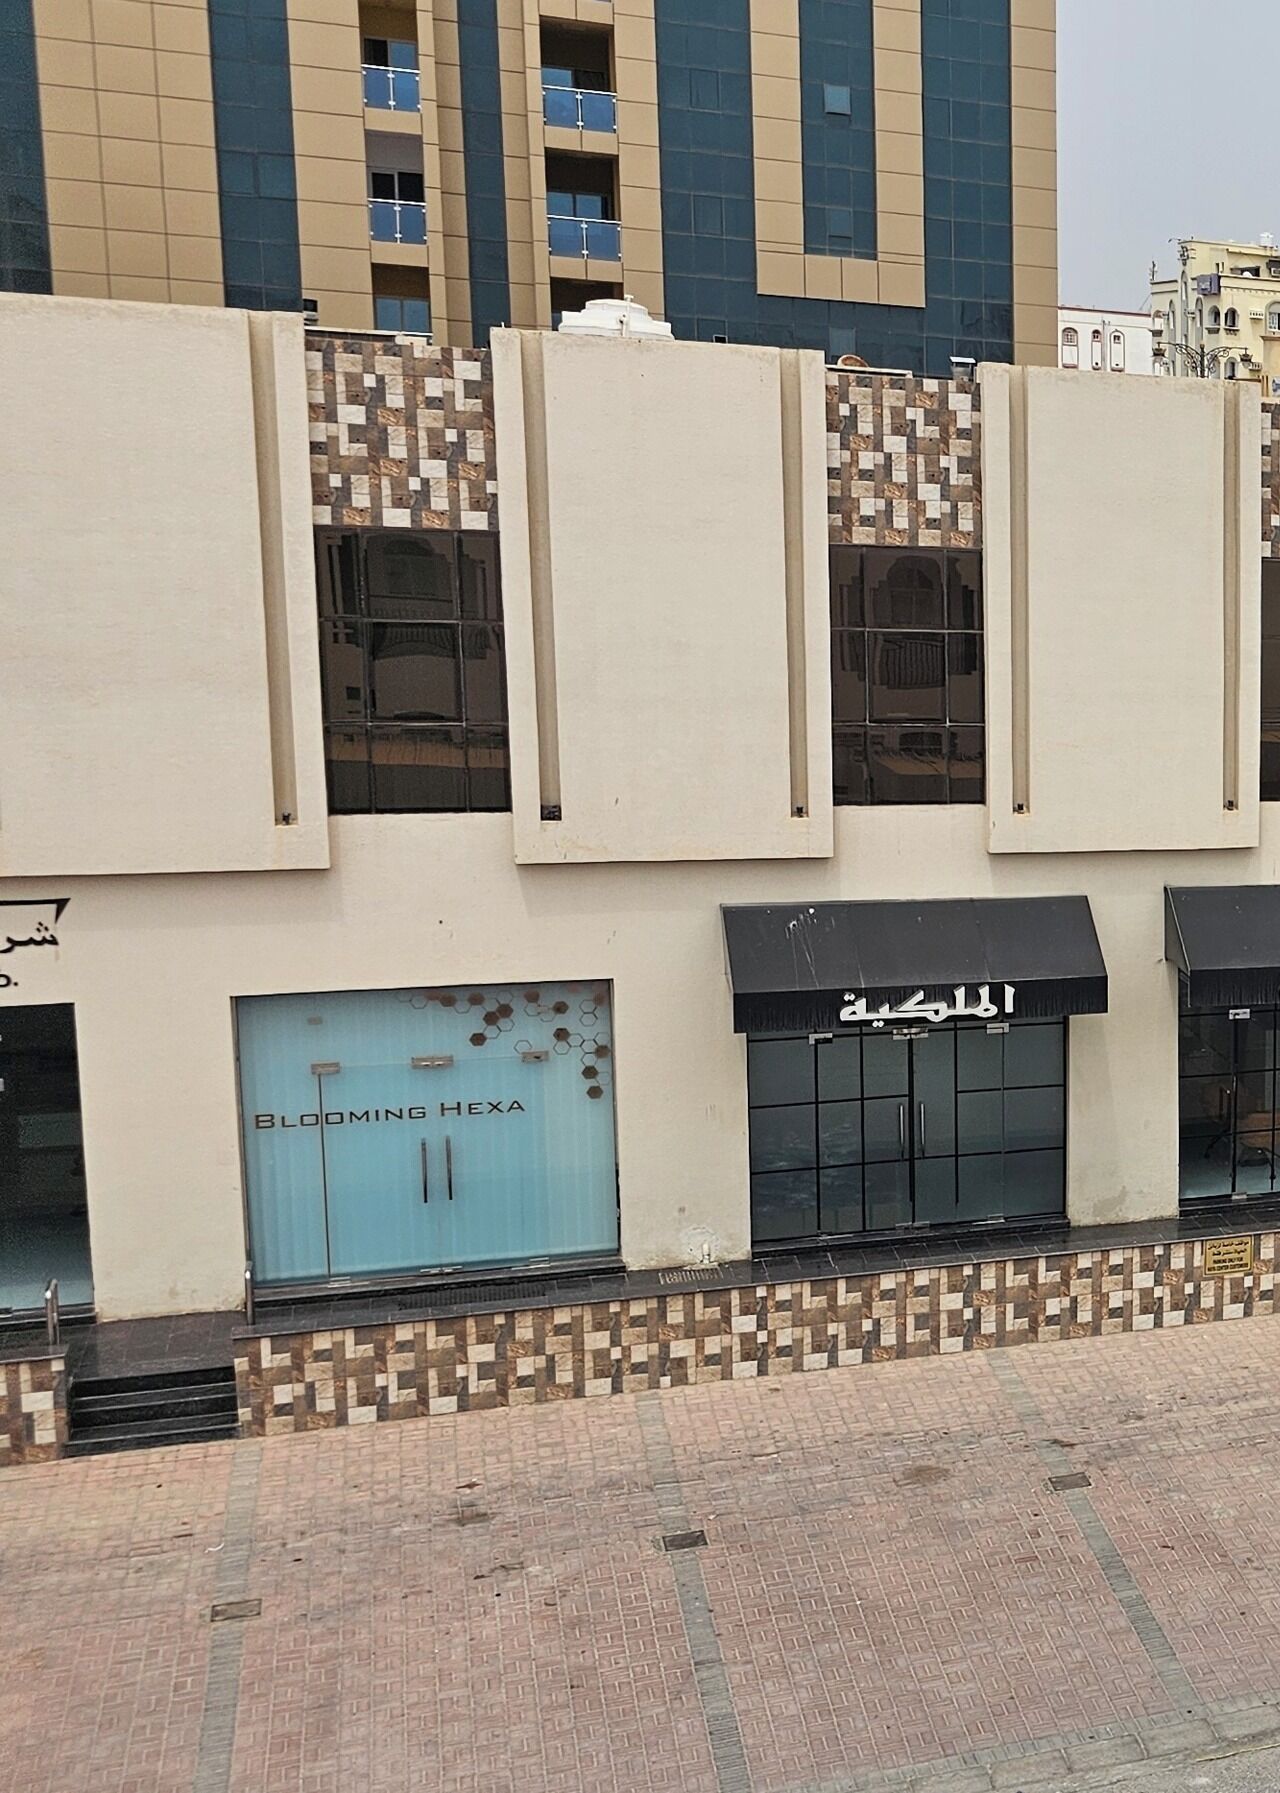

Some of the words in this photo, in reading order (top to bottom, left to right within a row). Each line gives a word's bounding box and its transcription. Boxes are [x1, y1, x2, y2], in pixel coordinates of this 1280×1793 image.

[839, 983, 1016, 1029] الملكية
[254, 1106, 427, 1130] BLOOMING
[440, 1100, 526, 1117] HEXA
